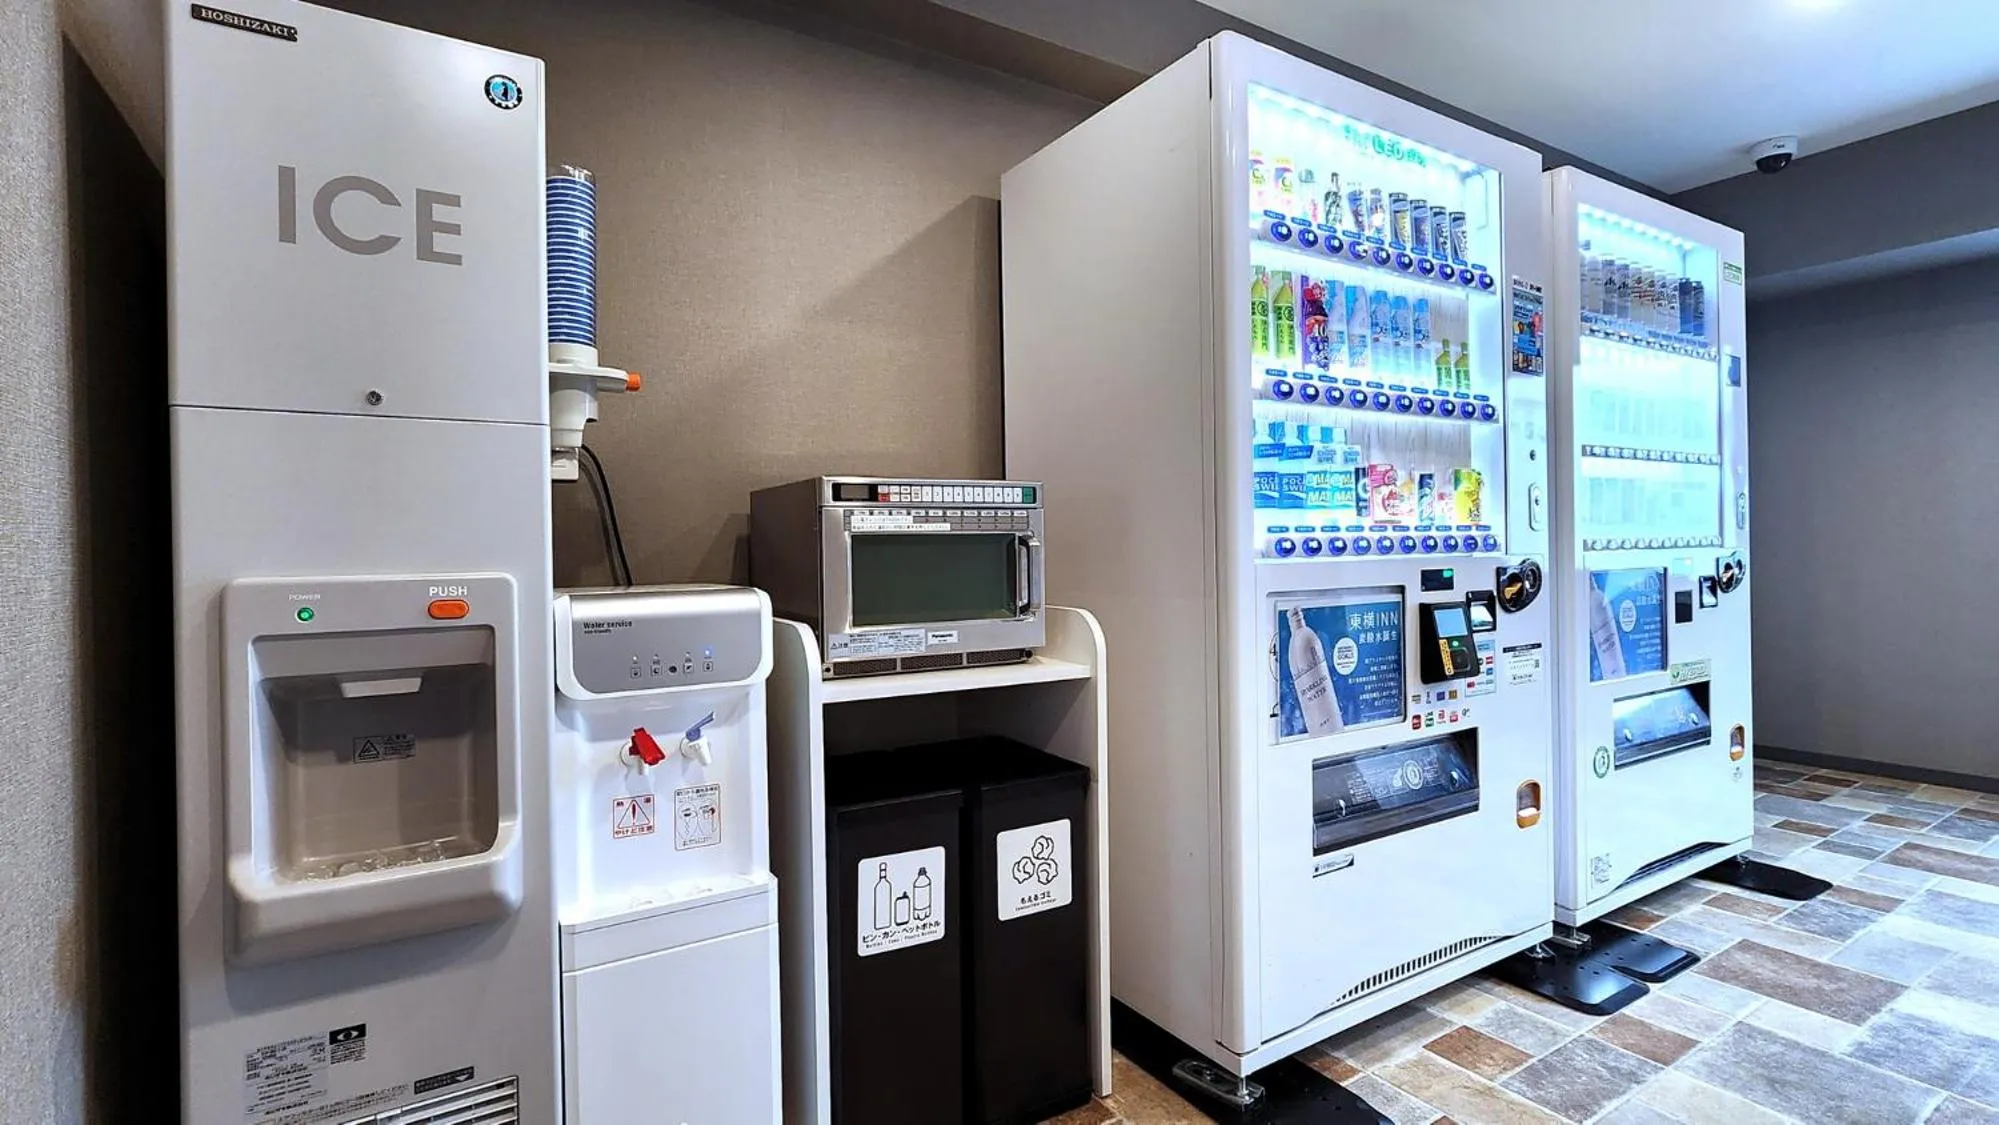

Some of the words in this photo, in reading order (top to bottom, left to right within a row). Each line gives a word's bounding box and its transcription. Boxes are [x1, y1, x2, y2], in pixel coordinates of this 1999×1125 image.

[200, 7, 289, 37] HOSHIZAKI
[277, 164, 463, 266] ICE
[288, 593, 321, 601] POWER
[428, 586, 468, 597] PUSH
[583, 620, 605, 630] Water
[607, 619, 633, 628] service
[1349, 610, 1399, 630] 東横INN
[1020, 891, 1052, 905] もえるゴミ
